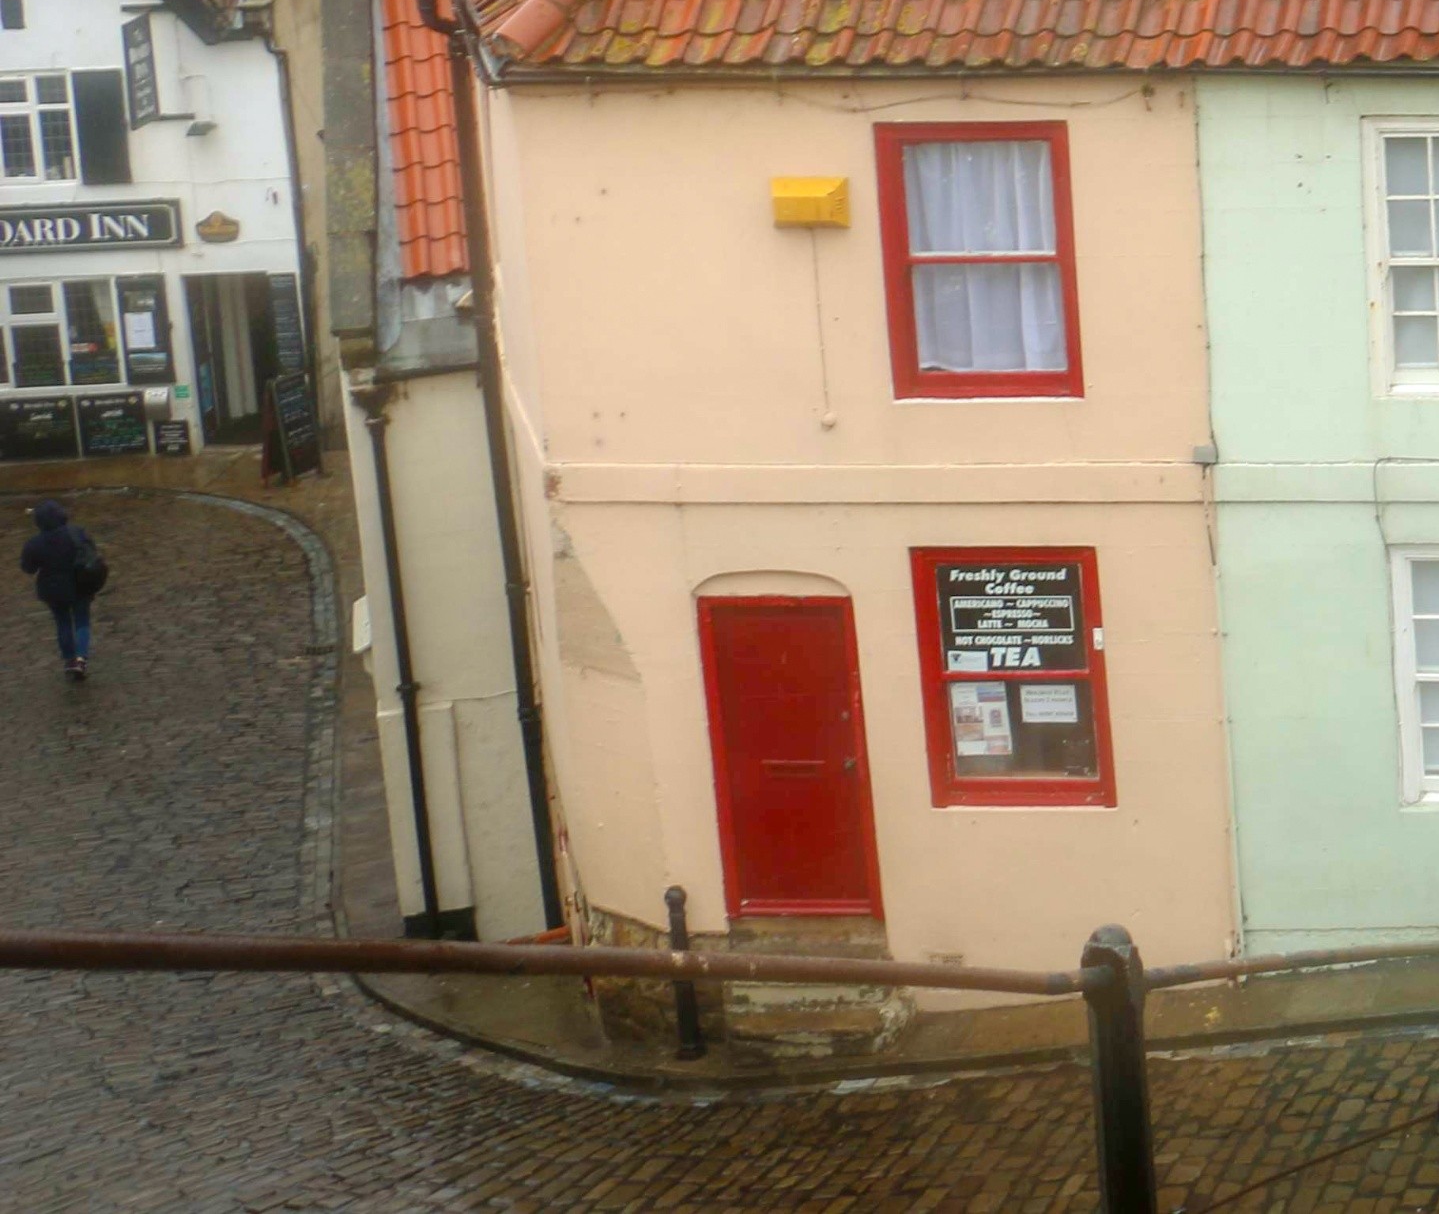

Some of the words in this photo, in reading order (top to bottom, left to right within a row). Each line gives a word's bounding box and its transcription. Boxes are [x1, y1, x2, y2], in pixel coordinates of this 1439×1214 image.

[89, 213, 149, 239] INN
[950, 569, 1005, 583] Freshly
[1009, 568, 1067, 581] Ground
[985, 582, 1035, 595] Coffee
[954, 599, 1004, 608] AMERICANO
[1016, 599, 1069, 608] CAPPUCCINO
[977, 619, 1003, 628] LATTE
[1017, 619, 1049, 628] MOCHA
[955, 636, 973, 645] HOT
[974, 635, 1022, 645] CHOCOLATE
[989, 646, 1042, 667] TEA
